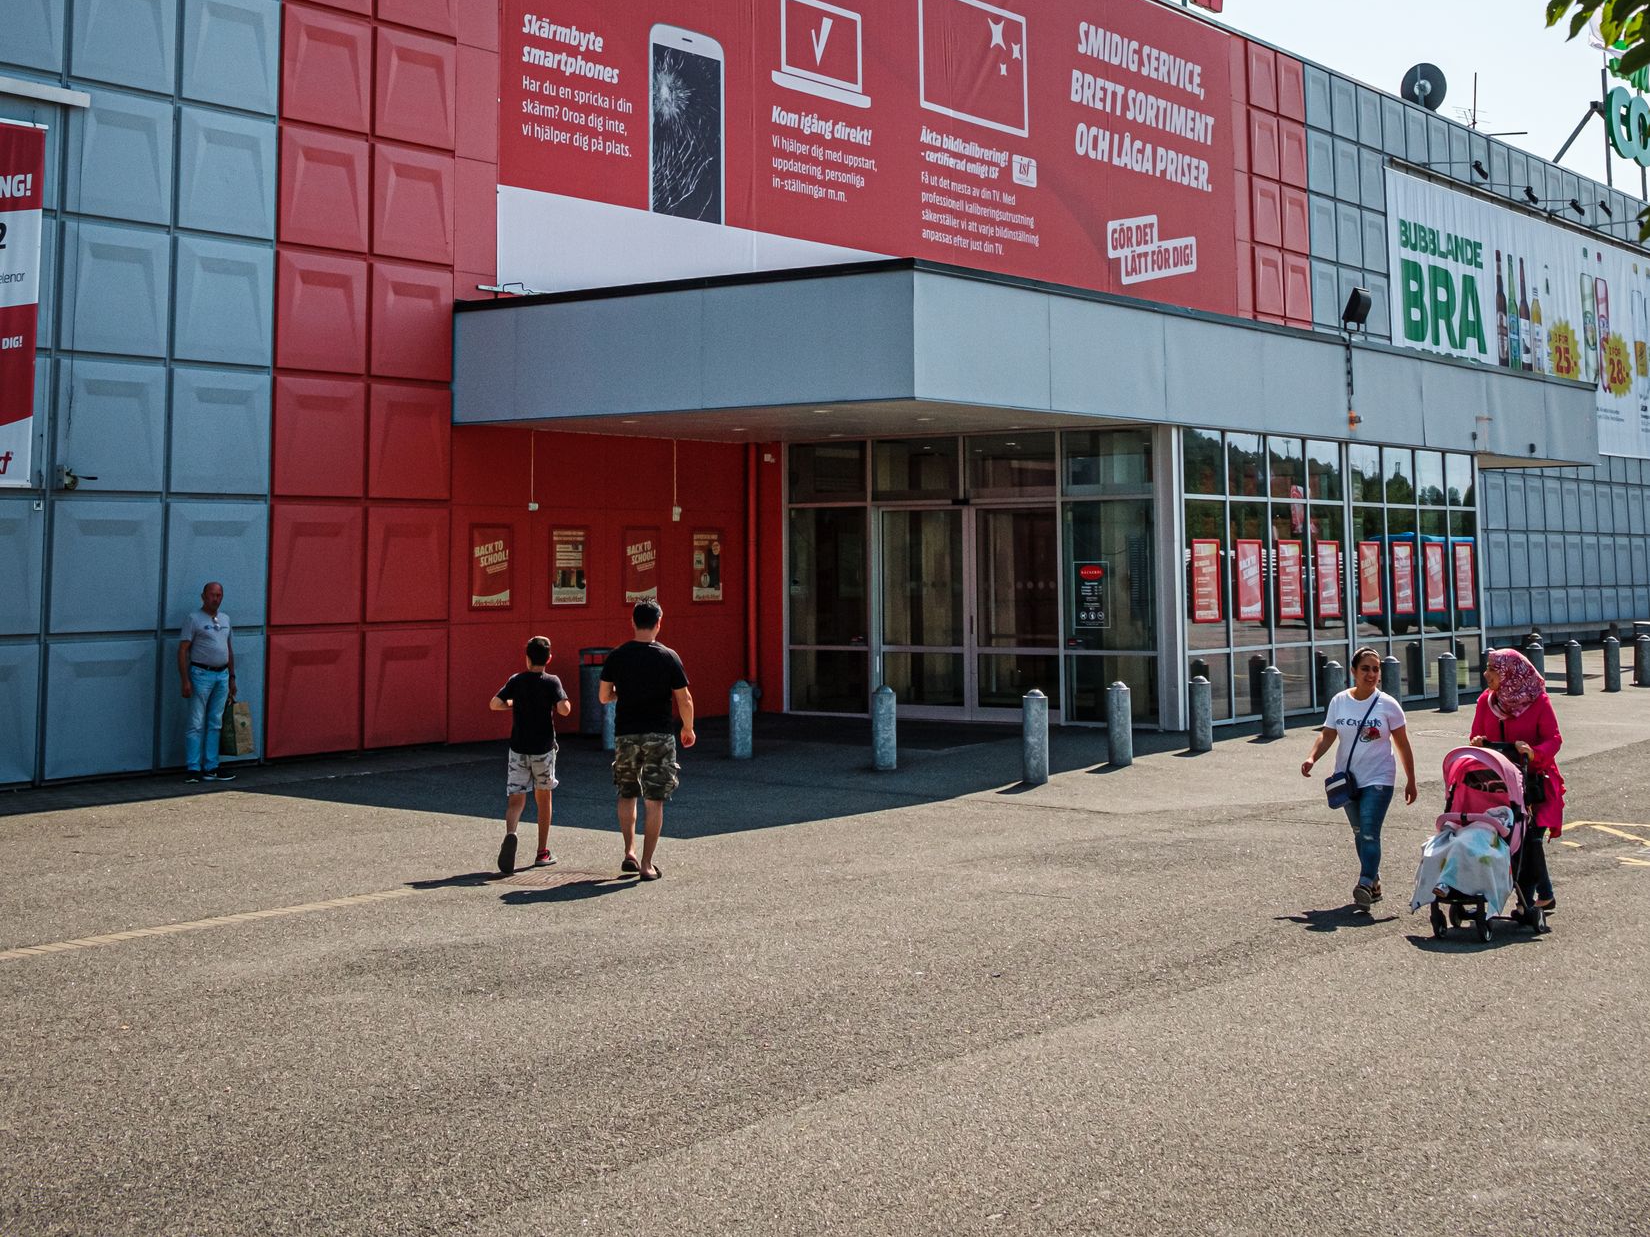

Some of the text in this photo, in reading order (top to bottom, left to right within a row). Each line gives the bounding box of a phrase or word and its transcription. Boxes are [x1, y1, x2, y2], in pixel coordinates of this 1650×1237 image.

[522, 13, 604, 52] Skärmbyte
[522, 45, 620, 84] smartphones
[1077, 21, 1205, 101] SMIDIG SERVICE,
[522, 75, 633, 114] Har du en spricka i din
[1070, 69, 1215, 146] BRETT SORTIMENT
[522, 99, 628, 137] skärm? Oroa dig inte,
[771, 105, 873, 147] Kom igång direkt!
[522, 122, 632, 158] vi hjälper dig på plats.
[771, 134, 878, 173] Vi hjälper dig med uppstart,
[920, 125, 1010, 168] Äkta bildkalibrering!
[1075, 122, 1213, 193] OCH LÅGA PRISER.
[772, 156, 865, 189] uppdatering, personliga
[925, 150, 966, 172] certifierad
[966, 162, 988, 179] enligt
[772, 174, 848, 203] in-ställningar m.m.
[920, 171, 929, 184] Få
[930, 175, 938, 187] ut
[938, 176, 951, 189] det
[950, 182, 971, 195] mesta
[972, 187, 981, 198] av
[980, 187, 992, 200] din
[1002, 192, 1016, 206] Med
[921, 191, 964, 212] professionell
[921, 229, 953, 245] anpassas
[953, 234, 970, 248] efter
[969, 240, 983, 252] just
[983, 241, 994, 254] din
[960, 217, 967, 230] vi
[968, 220, 978, 232] att
[978, 223, 995, 237] varje
[1111, 222, 1155, 252] GÖR DET
[1399, 217, 1484, 270] BUBBLANDE
[1124, 243, 1194, 277] LÄTT FÖR DIG!
[1400, 257, 1488, 355] BRA
[1, 335, 24, 350] DIG!
[474, 540, 504, 558] BACK TO
[480, 549, 509, 568] SCHOOL!
